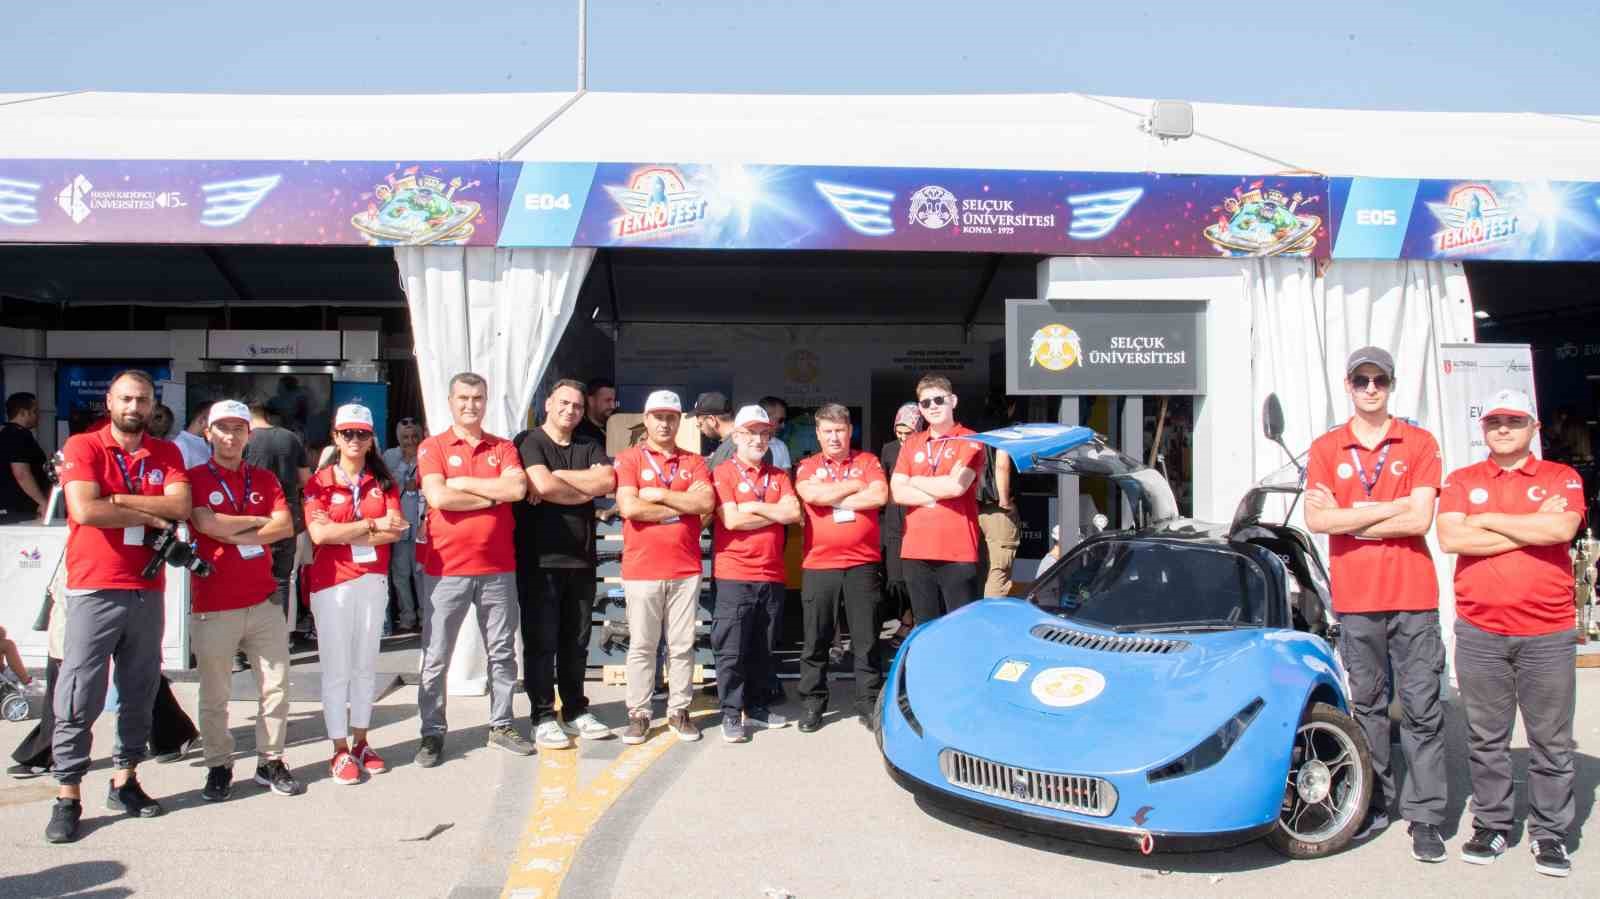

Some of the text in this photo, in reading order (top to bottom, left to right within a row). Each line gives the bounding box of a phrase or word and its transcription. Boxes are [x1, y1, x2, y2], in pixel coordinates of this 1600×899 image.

[525, 193, 571, 210] E04
[962, 199, 1014, 214] SELÇUK
[615, 200, 708, 236] TEKNOFEST
[962, 212, 1055, 227] ÜNİVERSİTESİ
[1356, 209, 1397, 225] E05
[962, 226, 992, 234] KONYA
[1439, 217, 1518, 250] TEKNOFEST
[1110, 336, 1165, 350] SELÇUK
[1089, 350, 1186, 364] ÜNİVERSİTESİ
